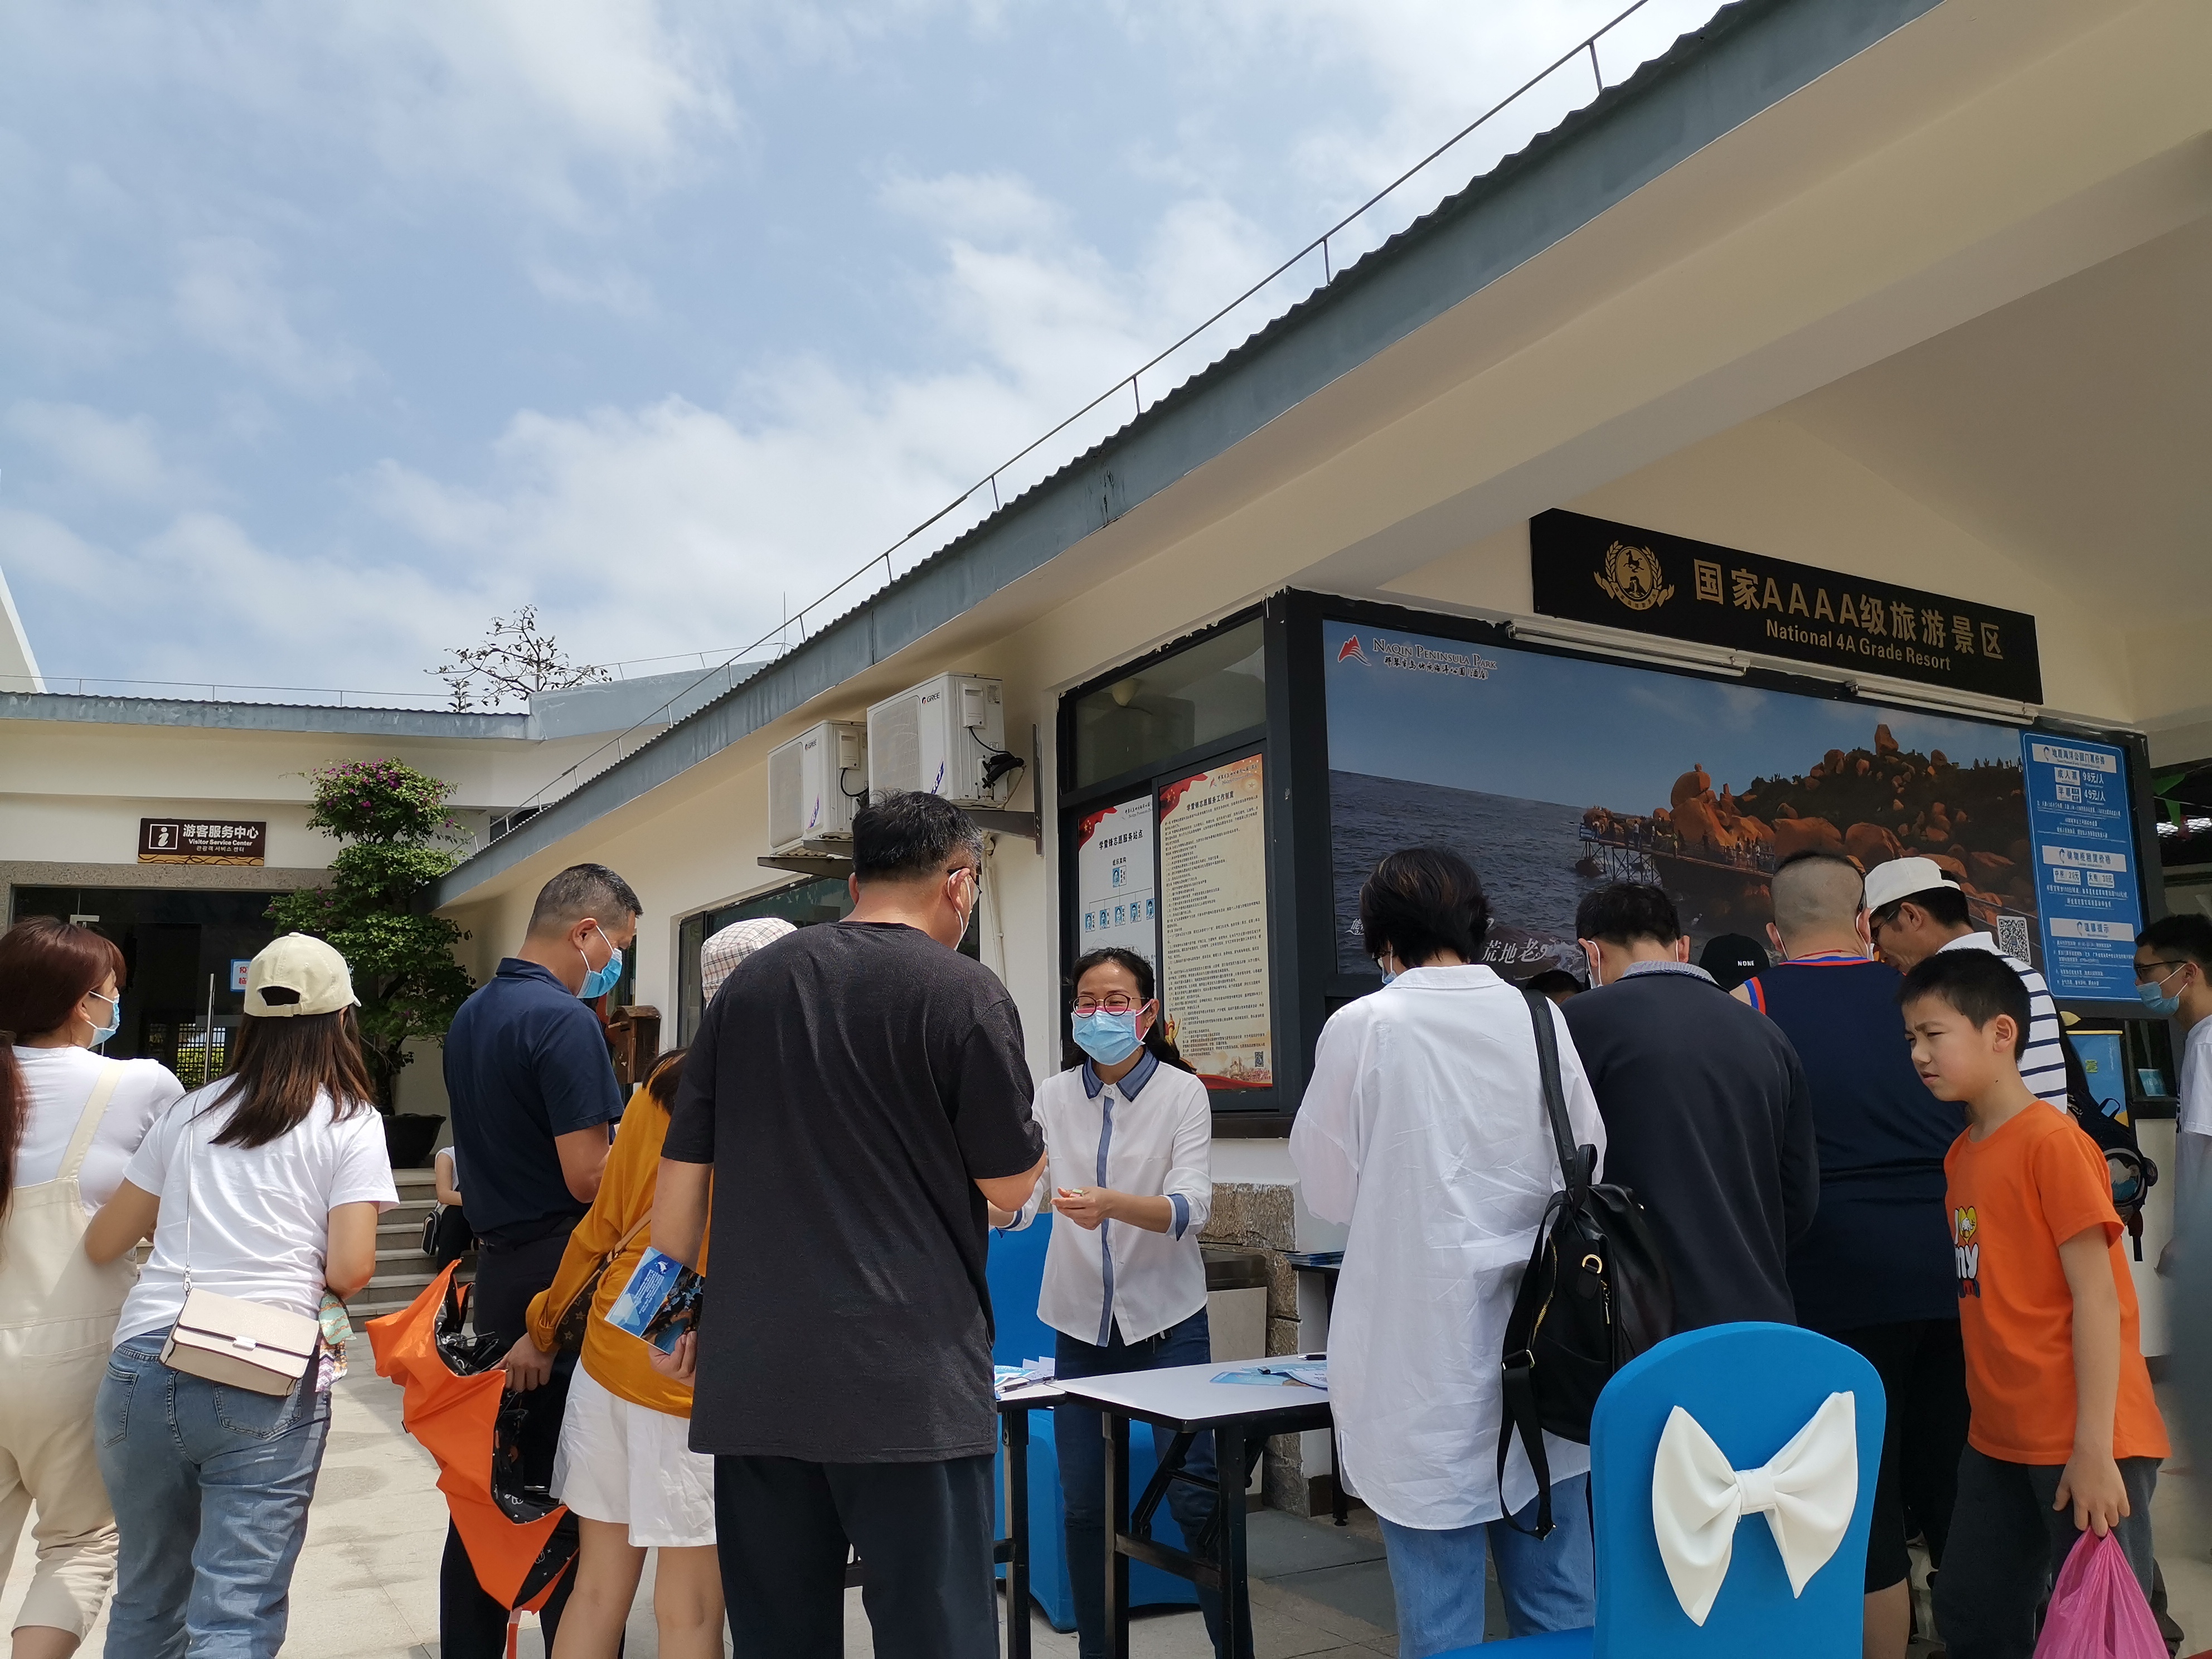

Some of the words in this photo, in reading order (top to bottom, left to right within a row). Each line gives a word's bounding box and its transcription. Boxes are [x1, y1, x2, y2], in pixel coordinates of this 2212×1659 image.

[1694, 558, 2004, 661] 国家AAAA级旅游景区
[1765, 618, 1832, 648] National
[1836, 633, 1856, 653] 4A
[1859, 638, 1903, 663] Grade
[1905, 645, 1951, 671] Resort
[927, 692, 940, 702] GREE
[183, 824, 259, 839] 游客服务中心
